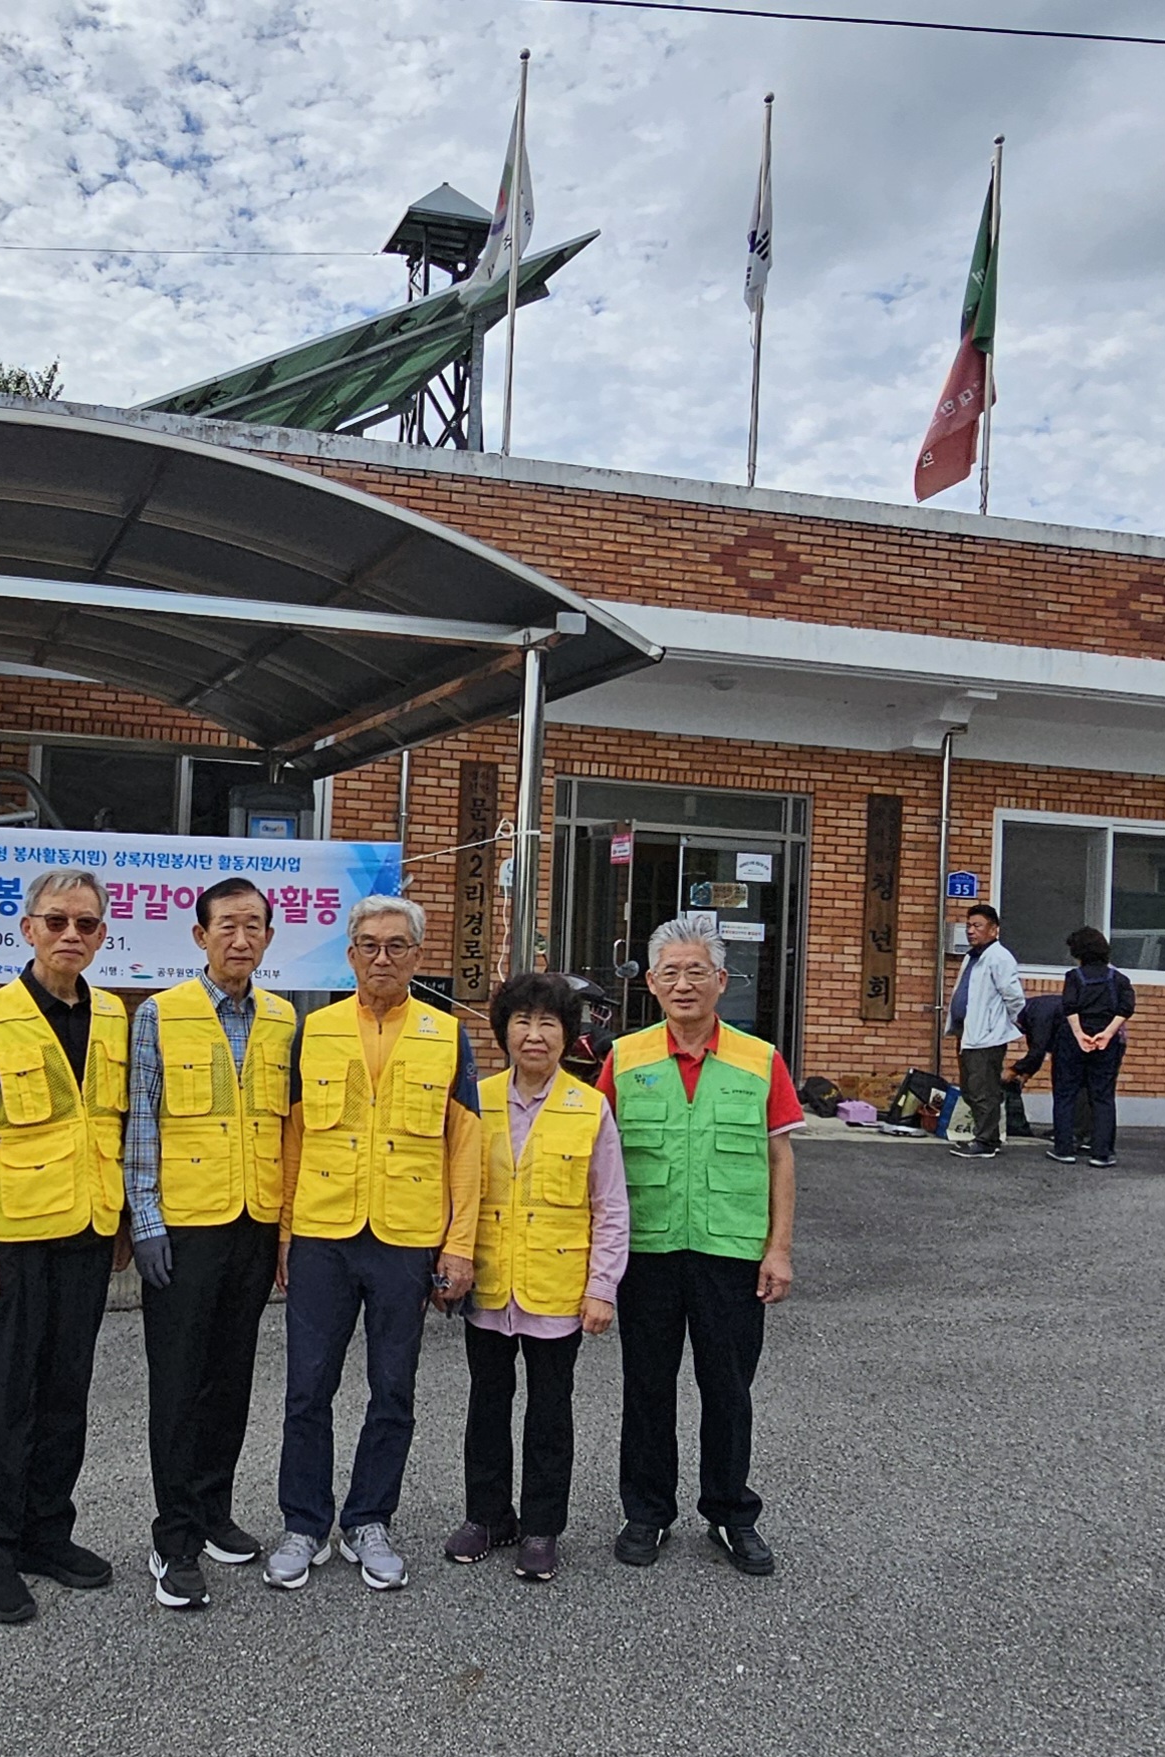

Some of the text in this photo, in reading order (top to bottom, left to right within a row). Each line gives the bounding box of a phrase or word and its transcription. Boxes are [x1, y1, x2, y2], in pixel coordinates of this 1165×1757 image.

[13, 846, 107, 867] 봉사활동지원)
[113, 851, 213, 870] 상록자원봉사단
[218, 854, 301, 873] 활동지원사업
[954, 883, 970, 895] 35
[105, 936, 131, 951] 31.
[250, 969, 281, 979] 전지부
